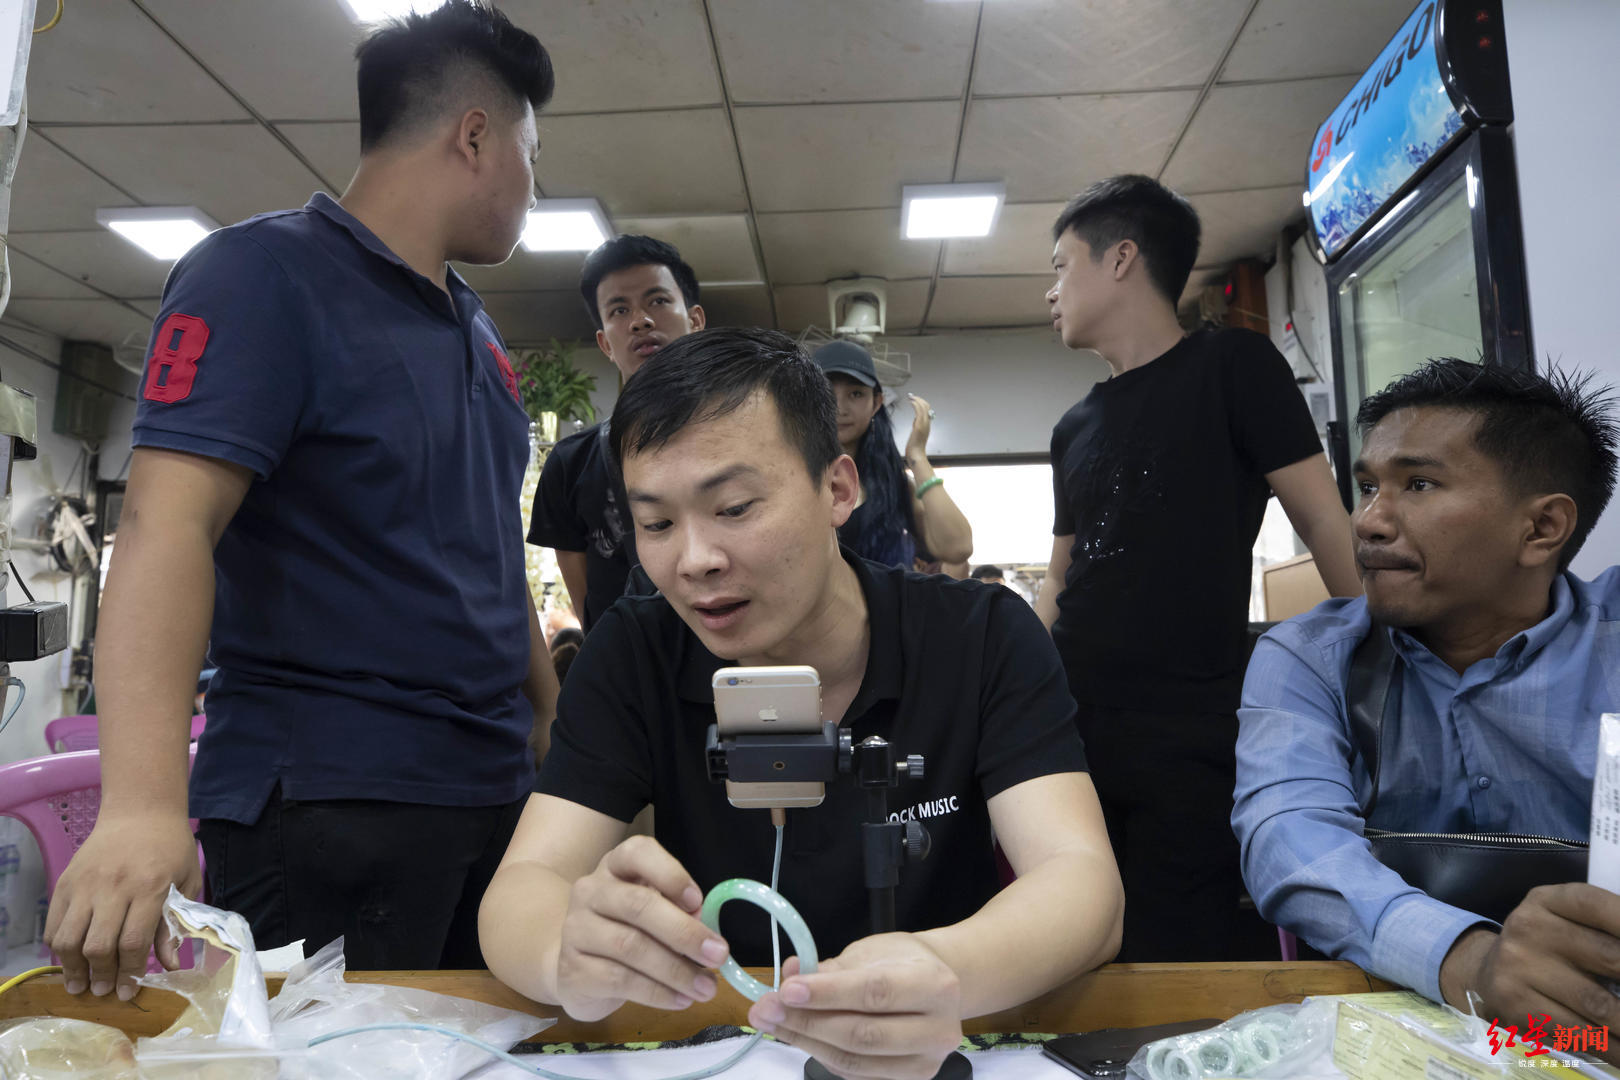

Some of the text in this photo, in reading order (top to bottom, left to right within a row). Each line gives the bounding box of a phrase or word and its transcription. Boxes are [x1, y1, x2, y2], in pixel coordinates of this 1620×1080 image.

[1335, 2, 1435, 146] CHIGO
[885, 795, 959, 824] OCK MUSIC
